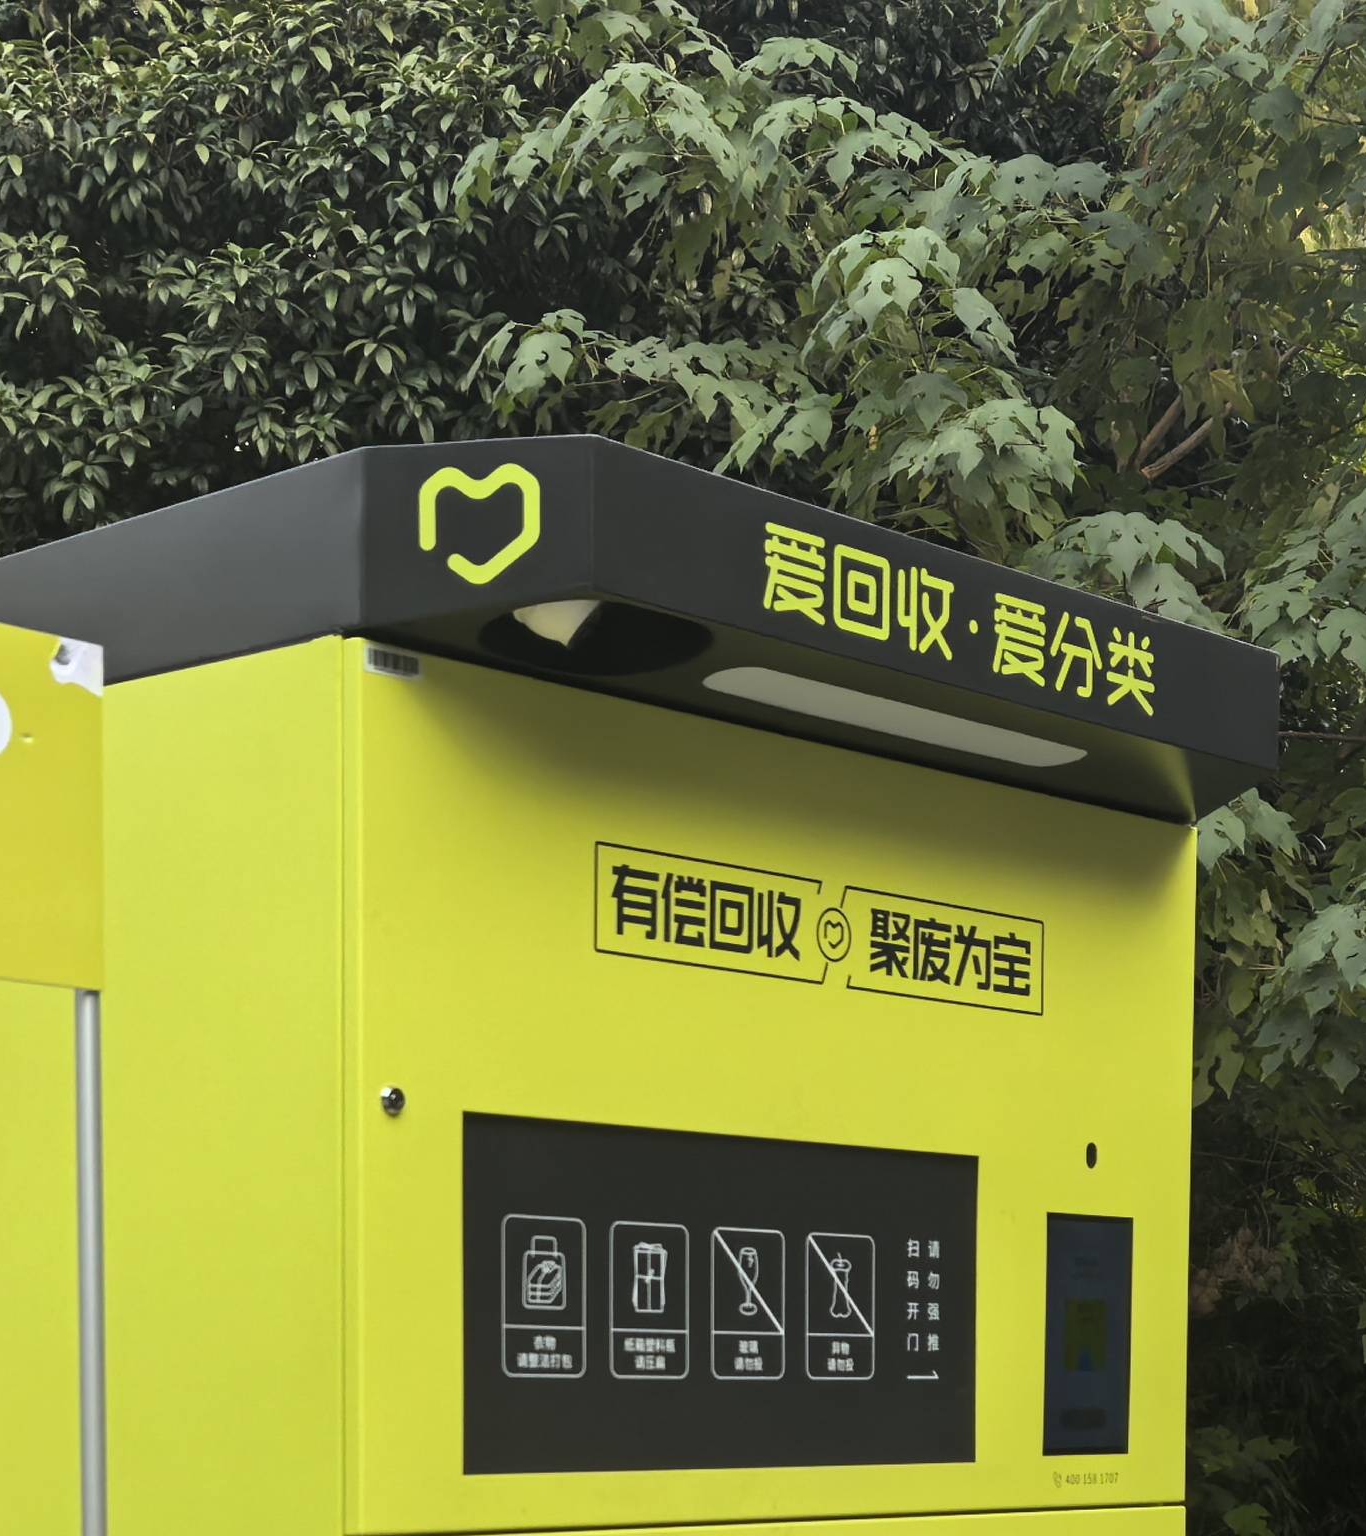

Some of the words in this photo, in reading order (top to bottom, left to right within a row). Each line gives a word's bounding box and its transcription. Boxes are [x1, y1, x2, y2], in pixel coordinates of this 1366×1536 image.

[762, 521, 1156, 717] 爱回收·爱分类
[610, 863, 802, 963] 有偿回收
[868, 906, 1033, 997] 聚废为宝
[906, 1238, 920, 1352] 扫码开门
[927, 1240, 940, 1352] 请勿强推
